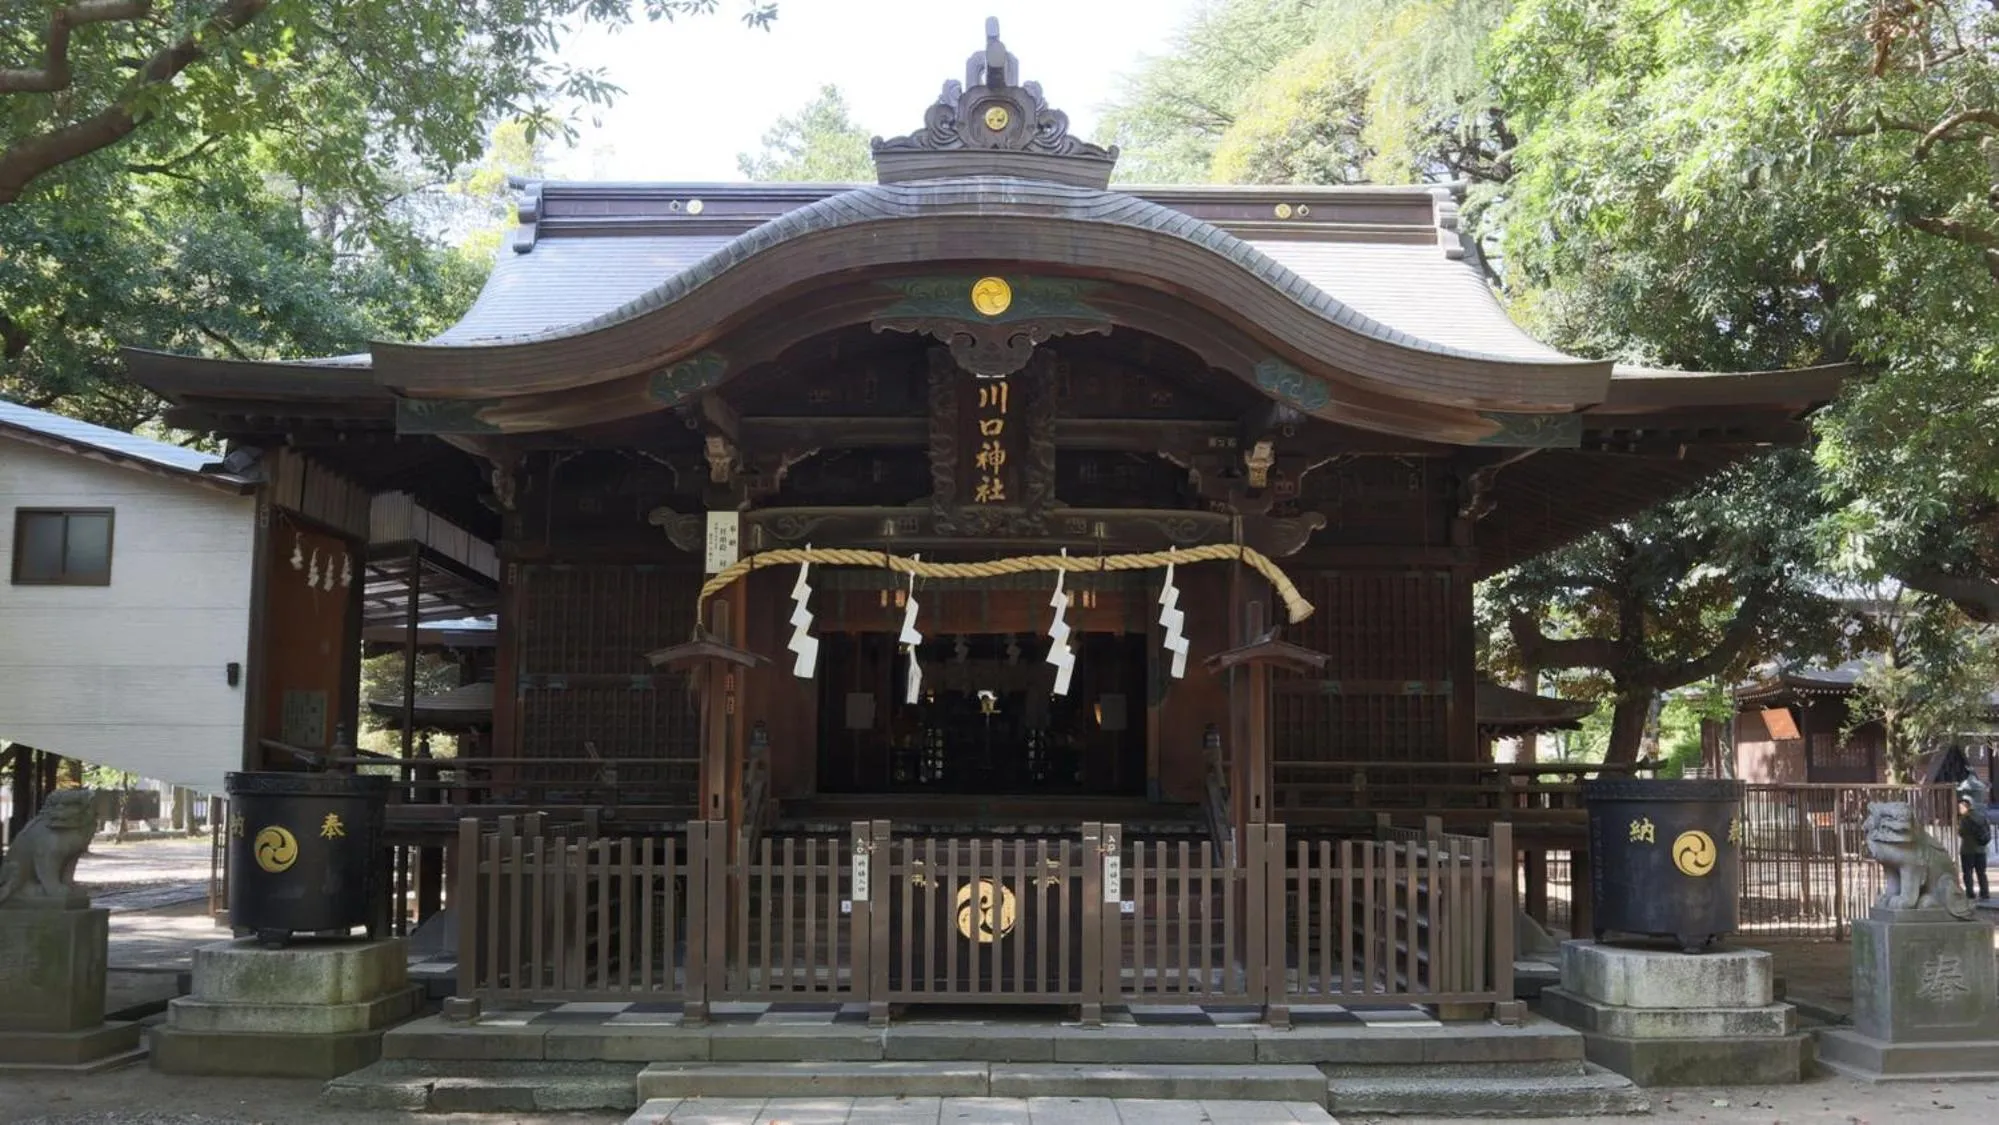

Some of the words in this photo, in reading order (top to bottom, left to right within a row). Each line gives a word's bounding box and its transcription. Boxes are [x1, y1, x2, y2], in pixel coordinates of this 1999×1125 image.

[975, 381, 1009, 503] 川口神社
[320, 812, 345, 841] 奉
[1629, 817, 1656, 844] 納
